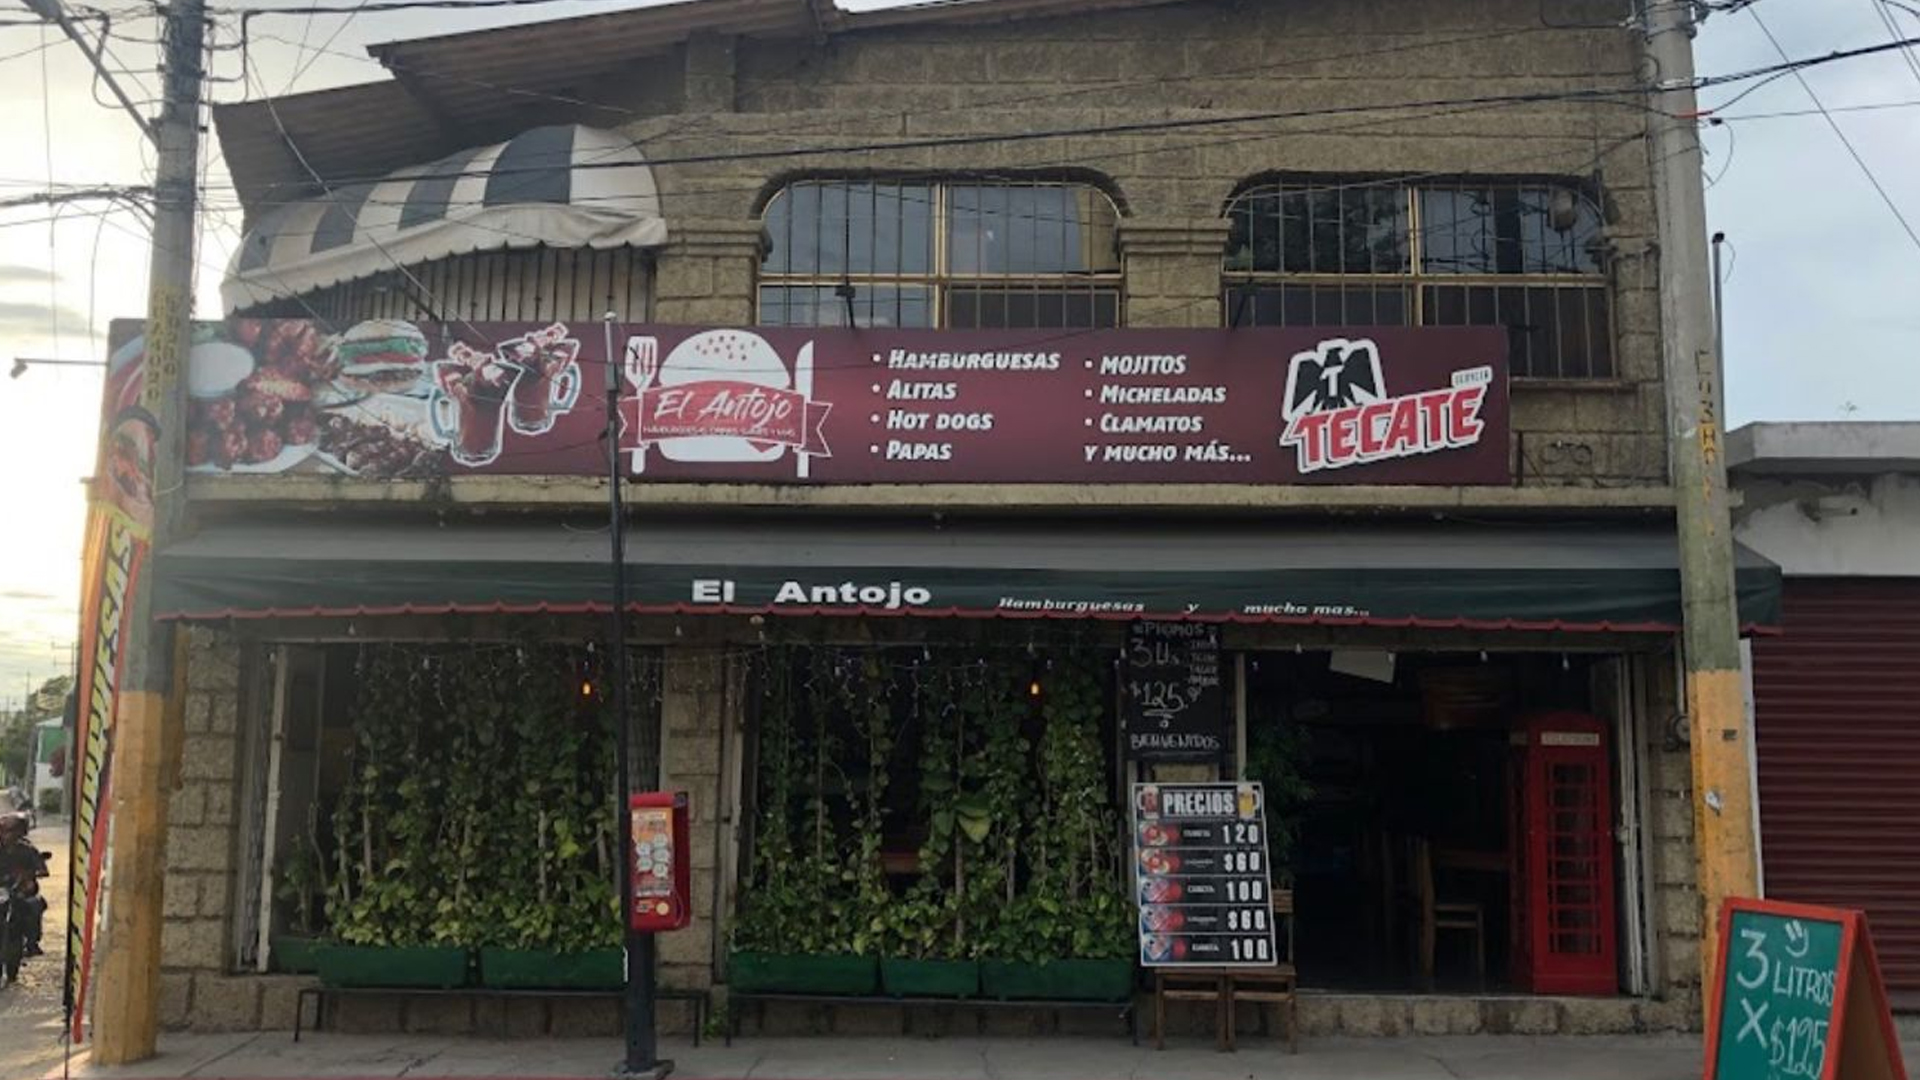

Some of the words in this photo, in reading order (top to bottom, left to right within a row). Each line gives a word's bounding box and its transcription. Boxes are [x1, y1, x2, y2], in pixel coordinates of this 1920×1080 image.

[888, 349, 1060, 370] HAMBURGUESAS
[1100, 355, 1187, 375] MOJITOS
[886, 380, 958, 399] ALITAS
[1100, 384, 1227, 403] MICHELADAS
[654, 390, 691, 419] El
[699, 388, 793, 430] Antojo
[886, 409, 930, 430] HOT
[936, 413, 994, 430] DOGS
[1100, 413, 1203, 432] CLAMATOS
[1290, 386, 1484, 465] TECATE
[886, 440, 953, 460] PAPAS
[1084, 445, 1098, 462] Y
[1104, 444, 1178, 462] MUCHO
[692, 580, 735, 602] El
[774, 581, 931, 609] Antojo
[999, 597, 1145, 613] Hamburguesas
[1183, 601, 1200, 614] y
[1244, 601, 1308, 615] mucho
[1163, 793, 1235, 815] PRECIOS
[1736, 929, 1770, 989] 3
[1773, 959, 1838, 1008] LITROS
[1736, 998, 1769, 1049] X
[1769, 1016, 1829, 1080] $125
